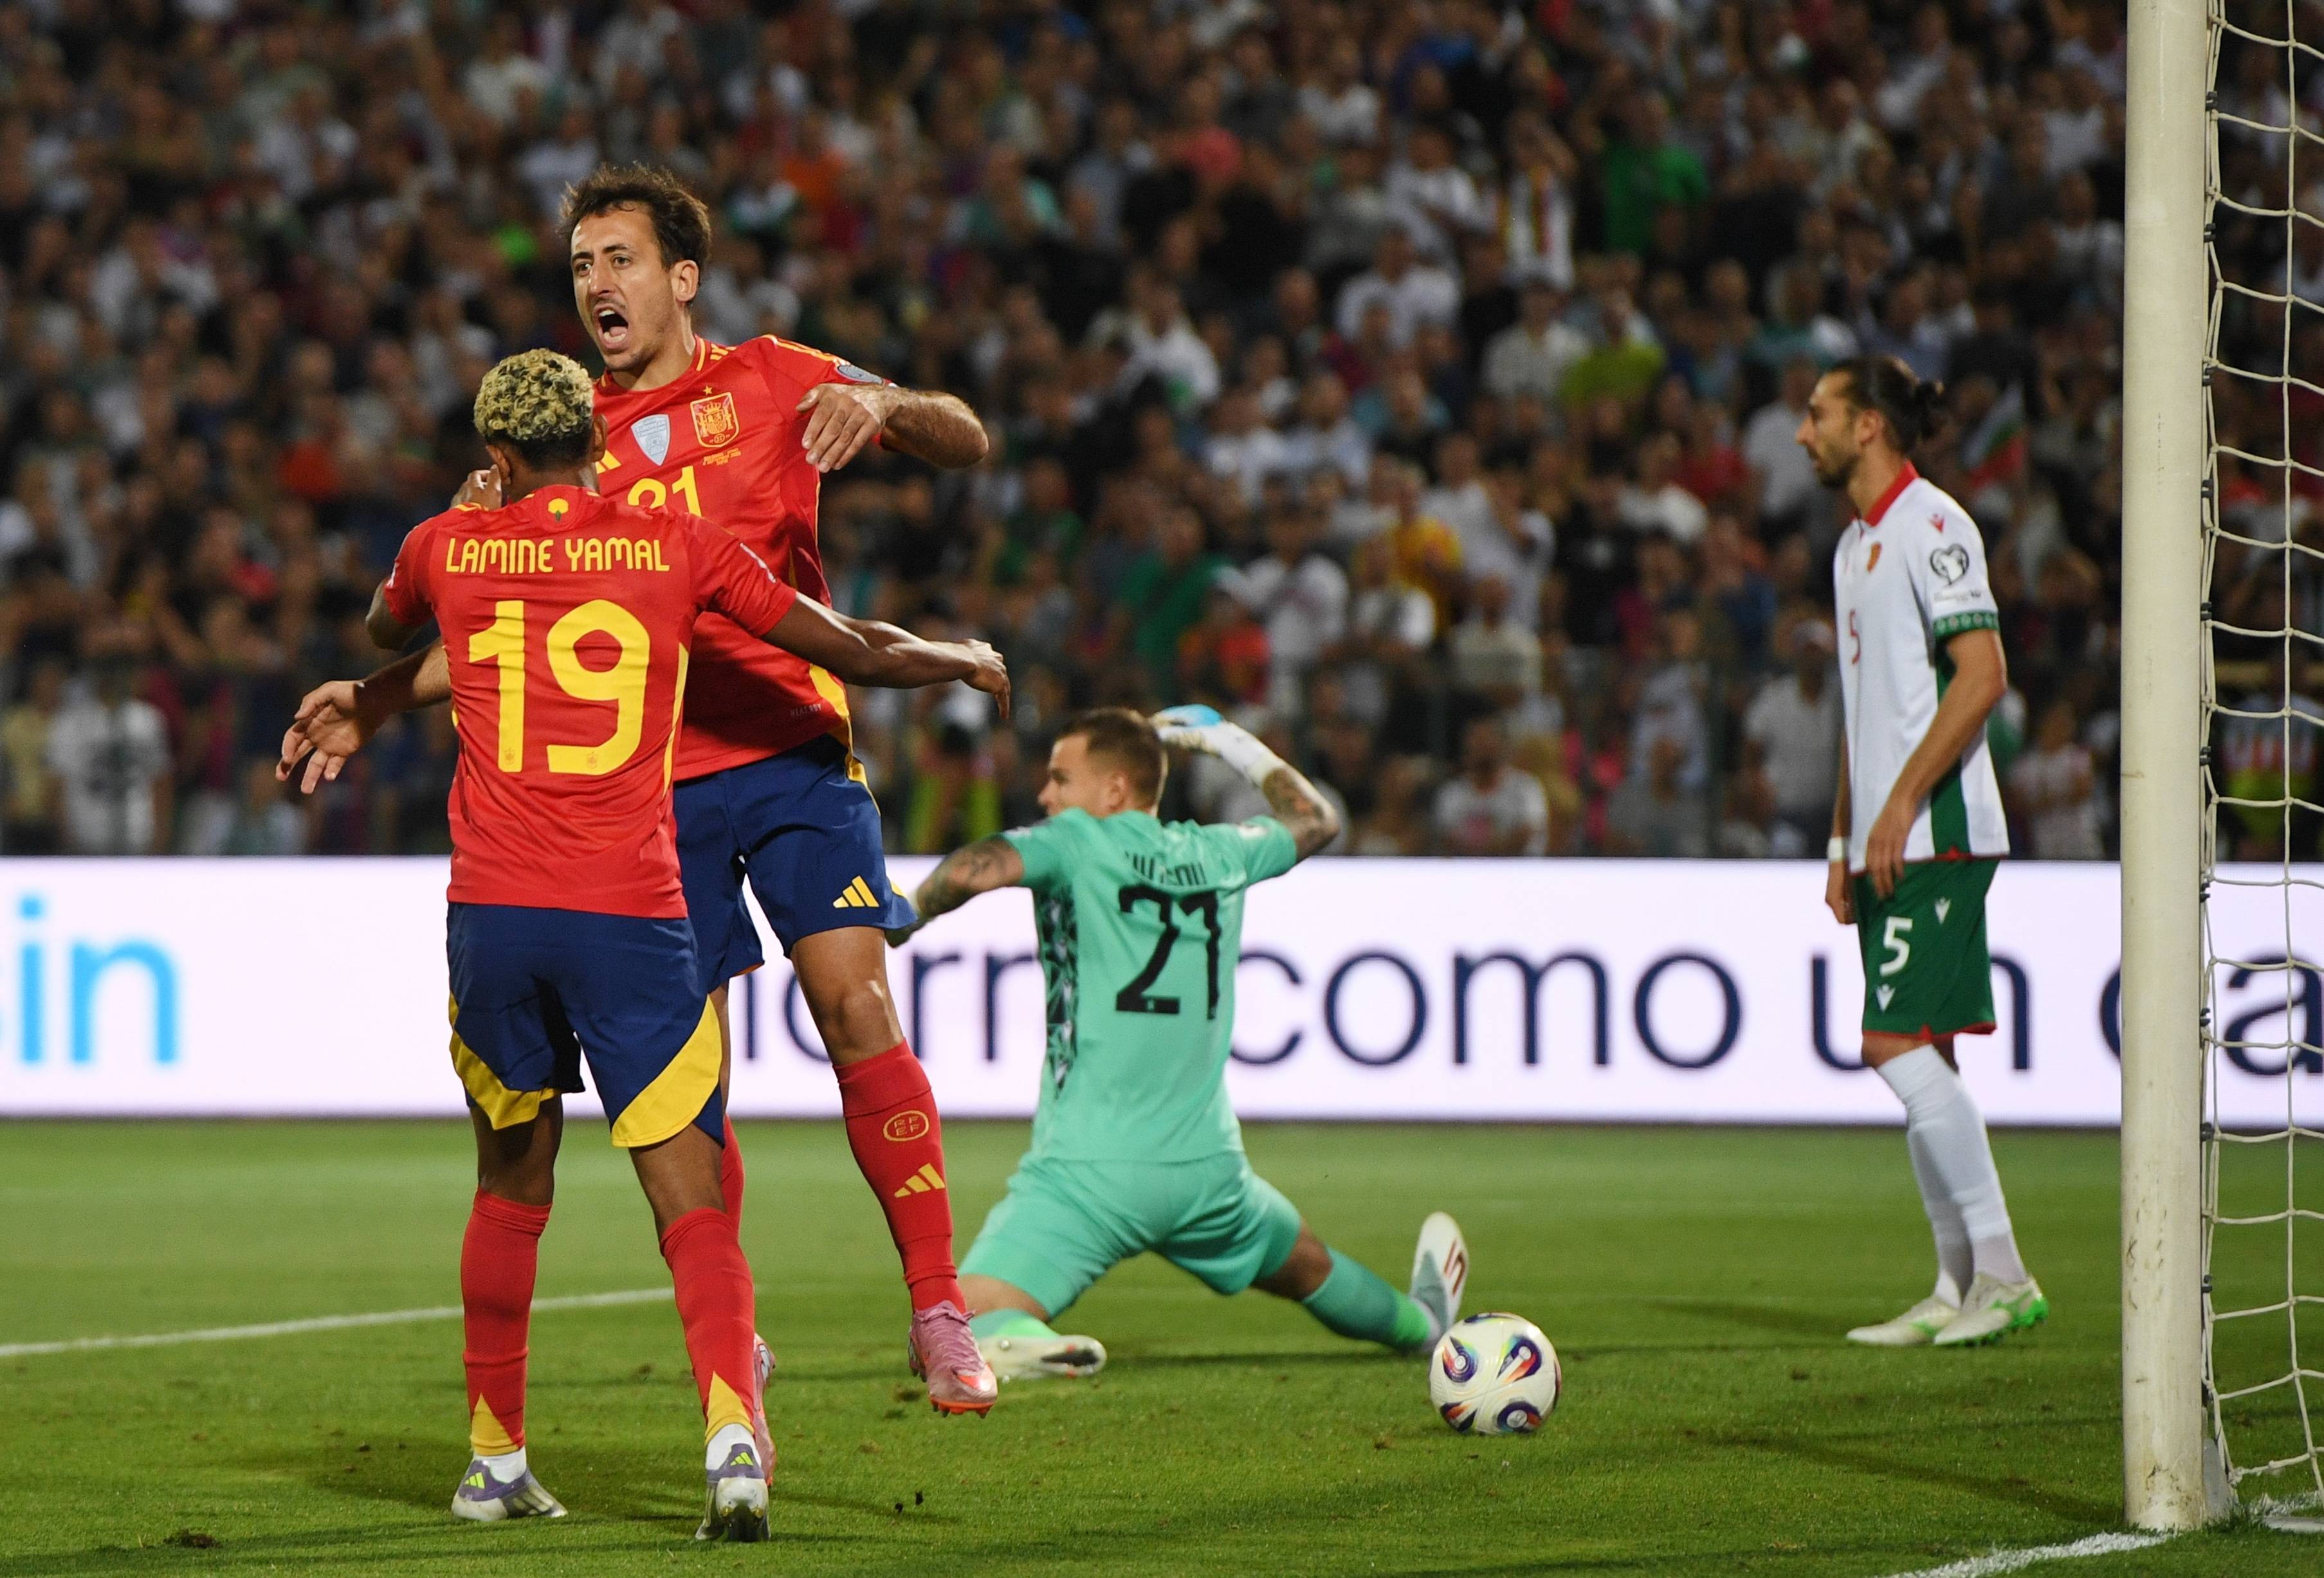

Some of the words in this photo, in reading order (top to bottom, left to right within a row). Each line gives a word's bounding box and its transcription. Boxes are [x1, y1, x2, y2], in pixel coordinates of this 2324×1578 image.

[446, 538, 554, 574] LAMINE
[565, 537, 670, 572] YAMAL
[468, 599, 650, 775] 19
[0, 894, 180, 1066] in
[1115, 884, 1220, 1020] 21
[1880, 916, 1913, 976] 5
[1229, 952, 1743, 1069] como
